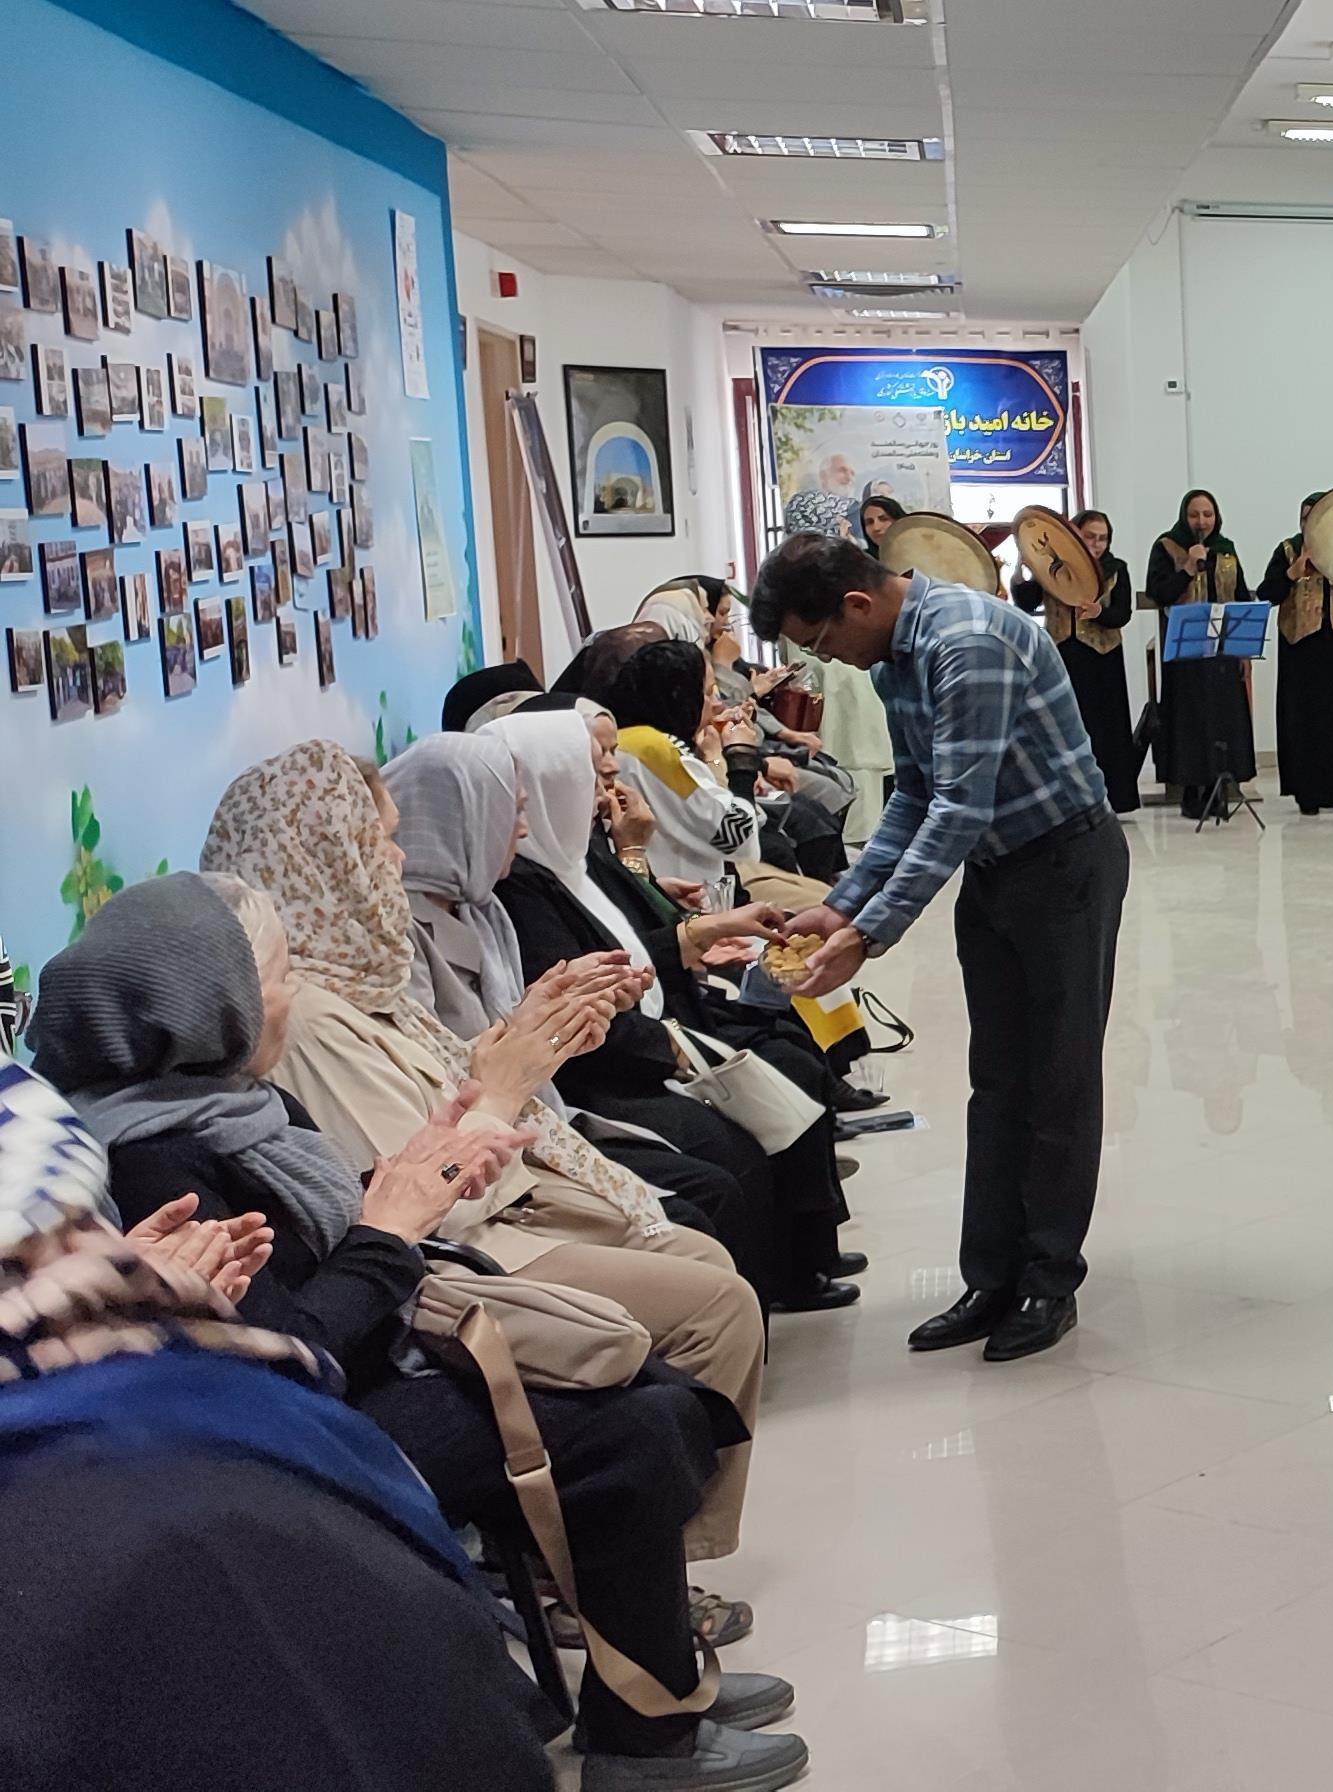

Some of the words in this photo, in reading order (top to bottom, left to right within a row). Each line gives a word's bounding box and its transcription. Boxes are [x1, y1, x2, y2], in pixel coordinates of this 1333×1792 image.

[969, 410, 1008, 436] امید
[1011, 410, 1054, 431] خانه
[983, 449, 1012, 465] استان
